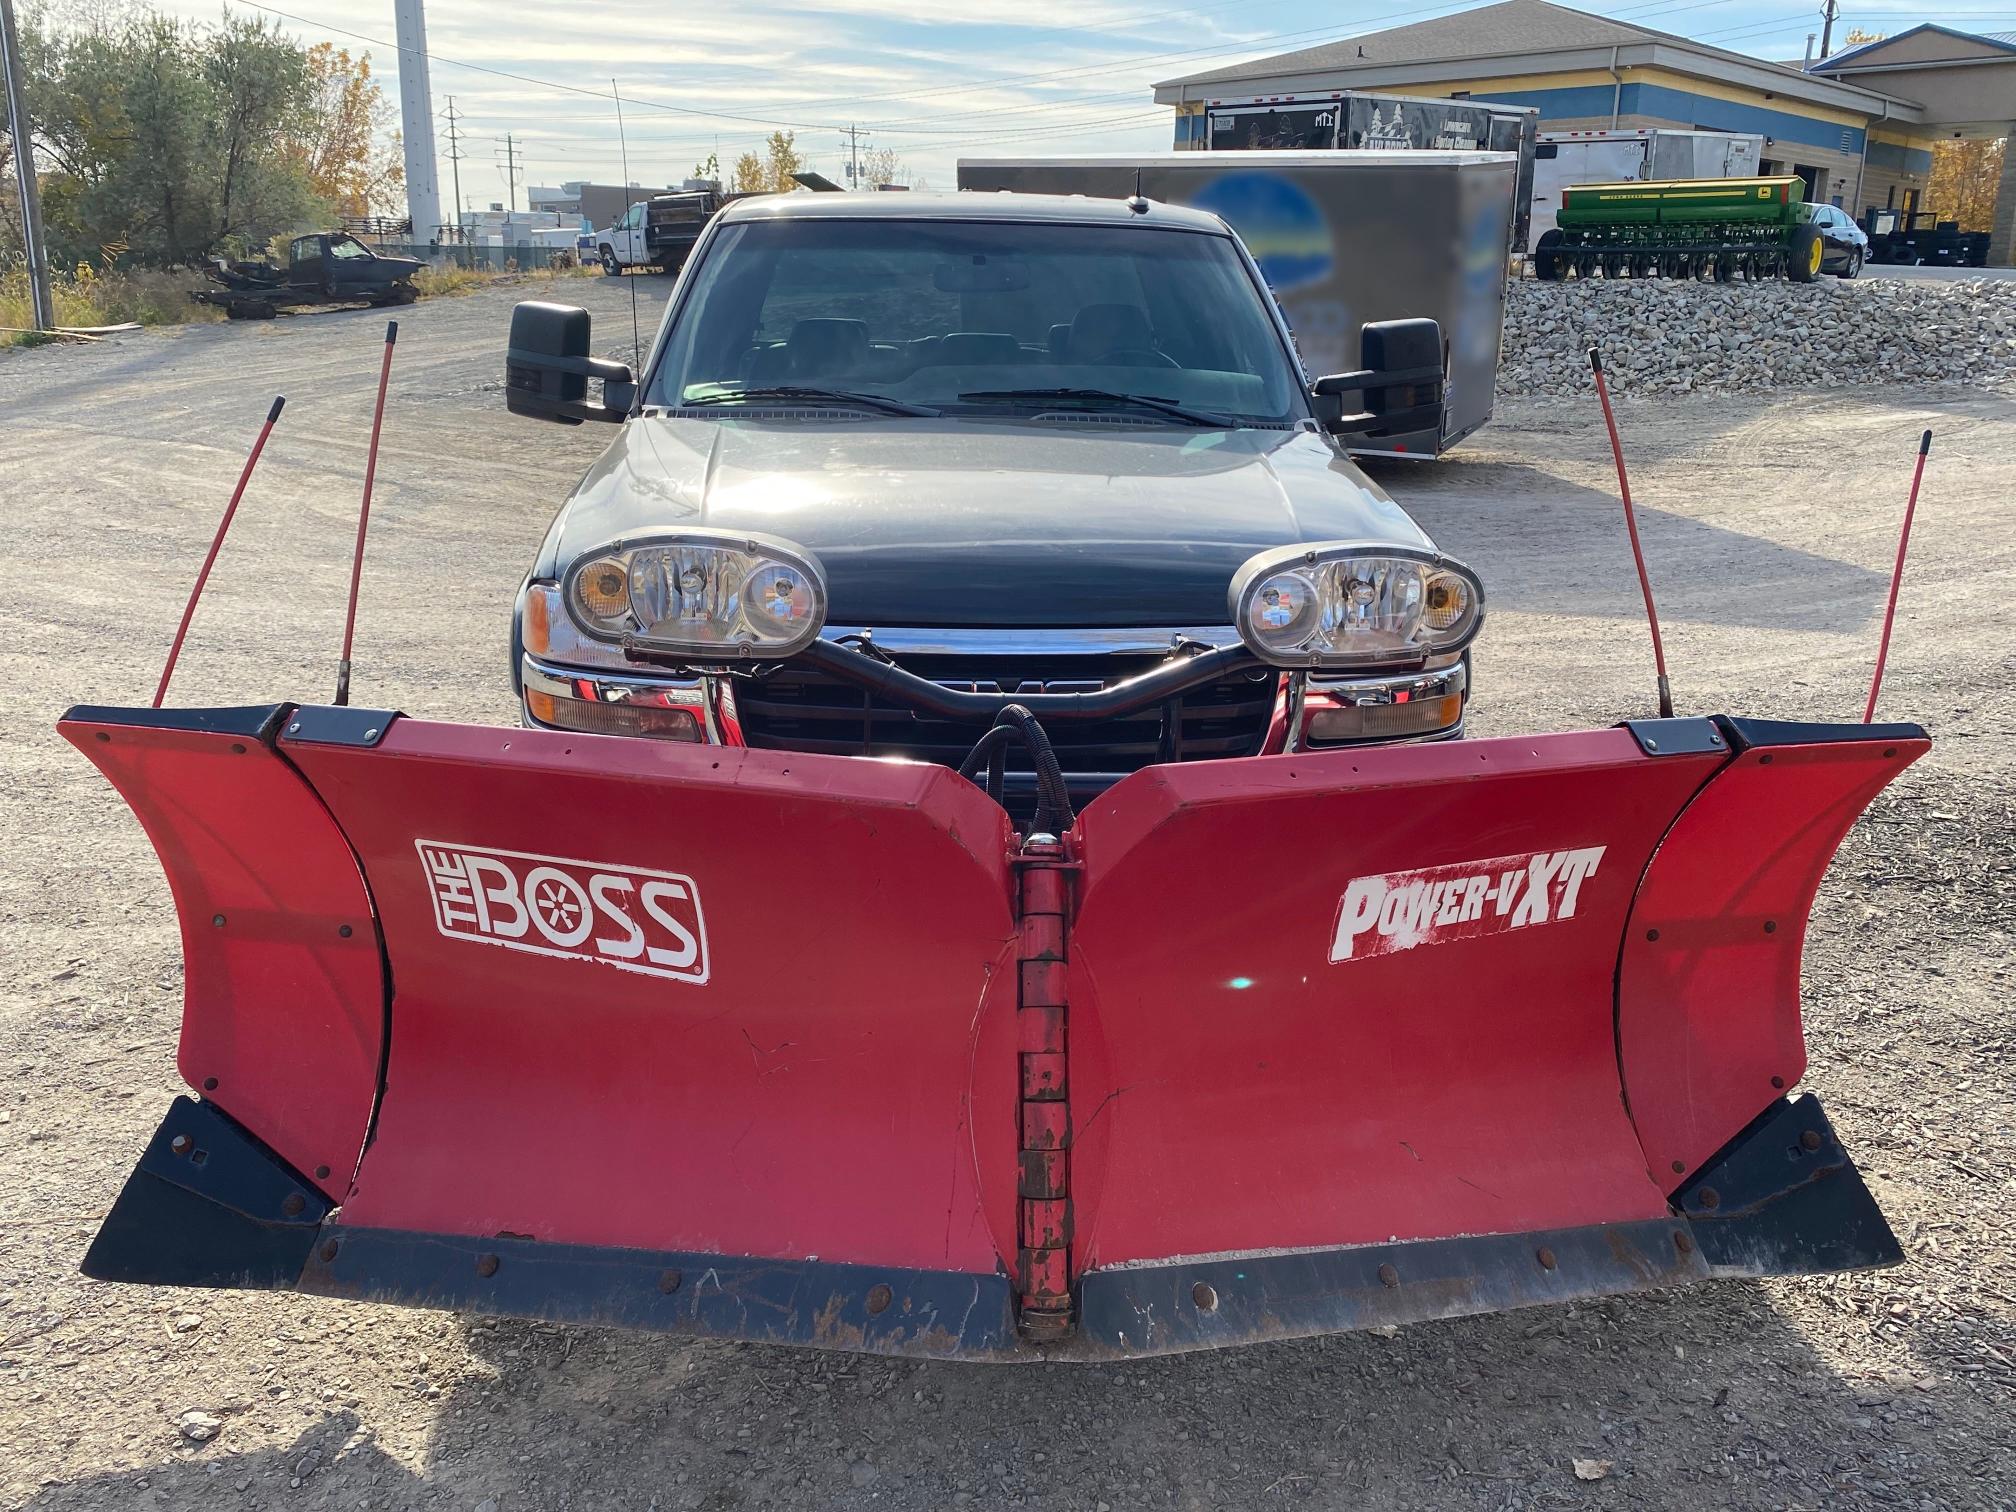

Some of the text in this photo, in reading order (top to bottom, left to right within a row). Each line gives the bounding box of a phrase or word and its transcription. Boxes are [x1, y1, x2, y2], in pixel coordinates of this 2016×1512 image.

[1315, 111, 1334, 127] MTI
[426, 849, 698, 968] THE BOSS
